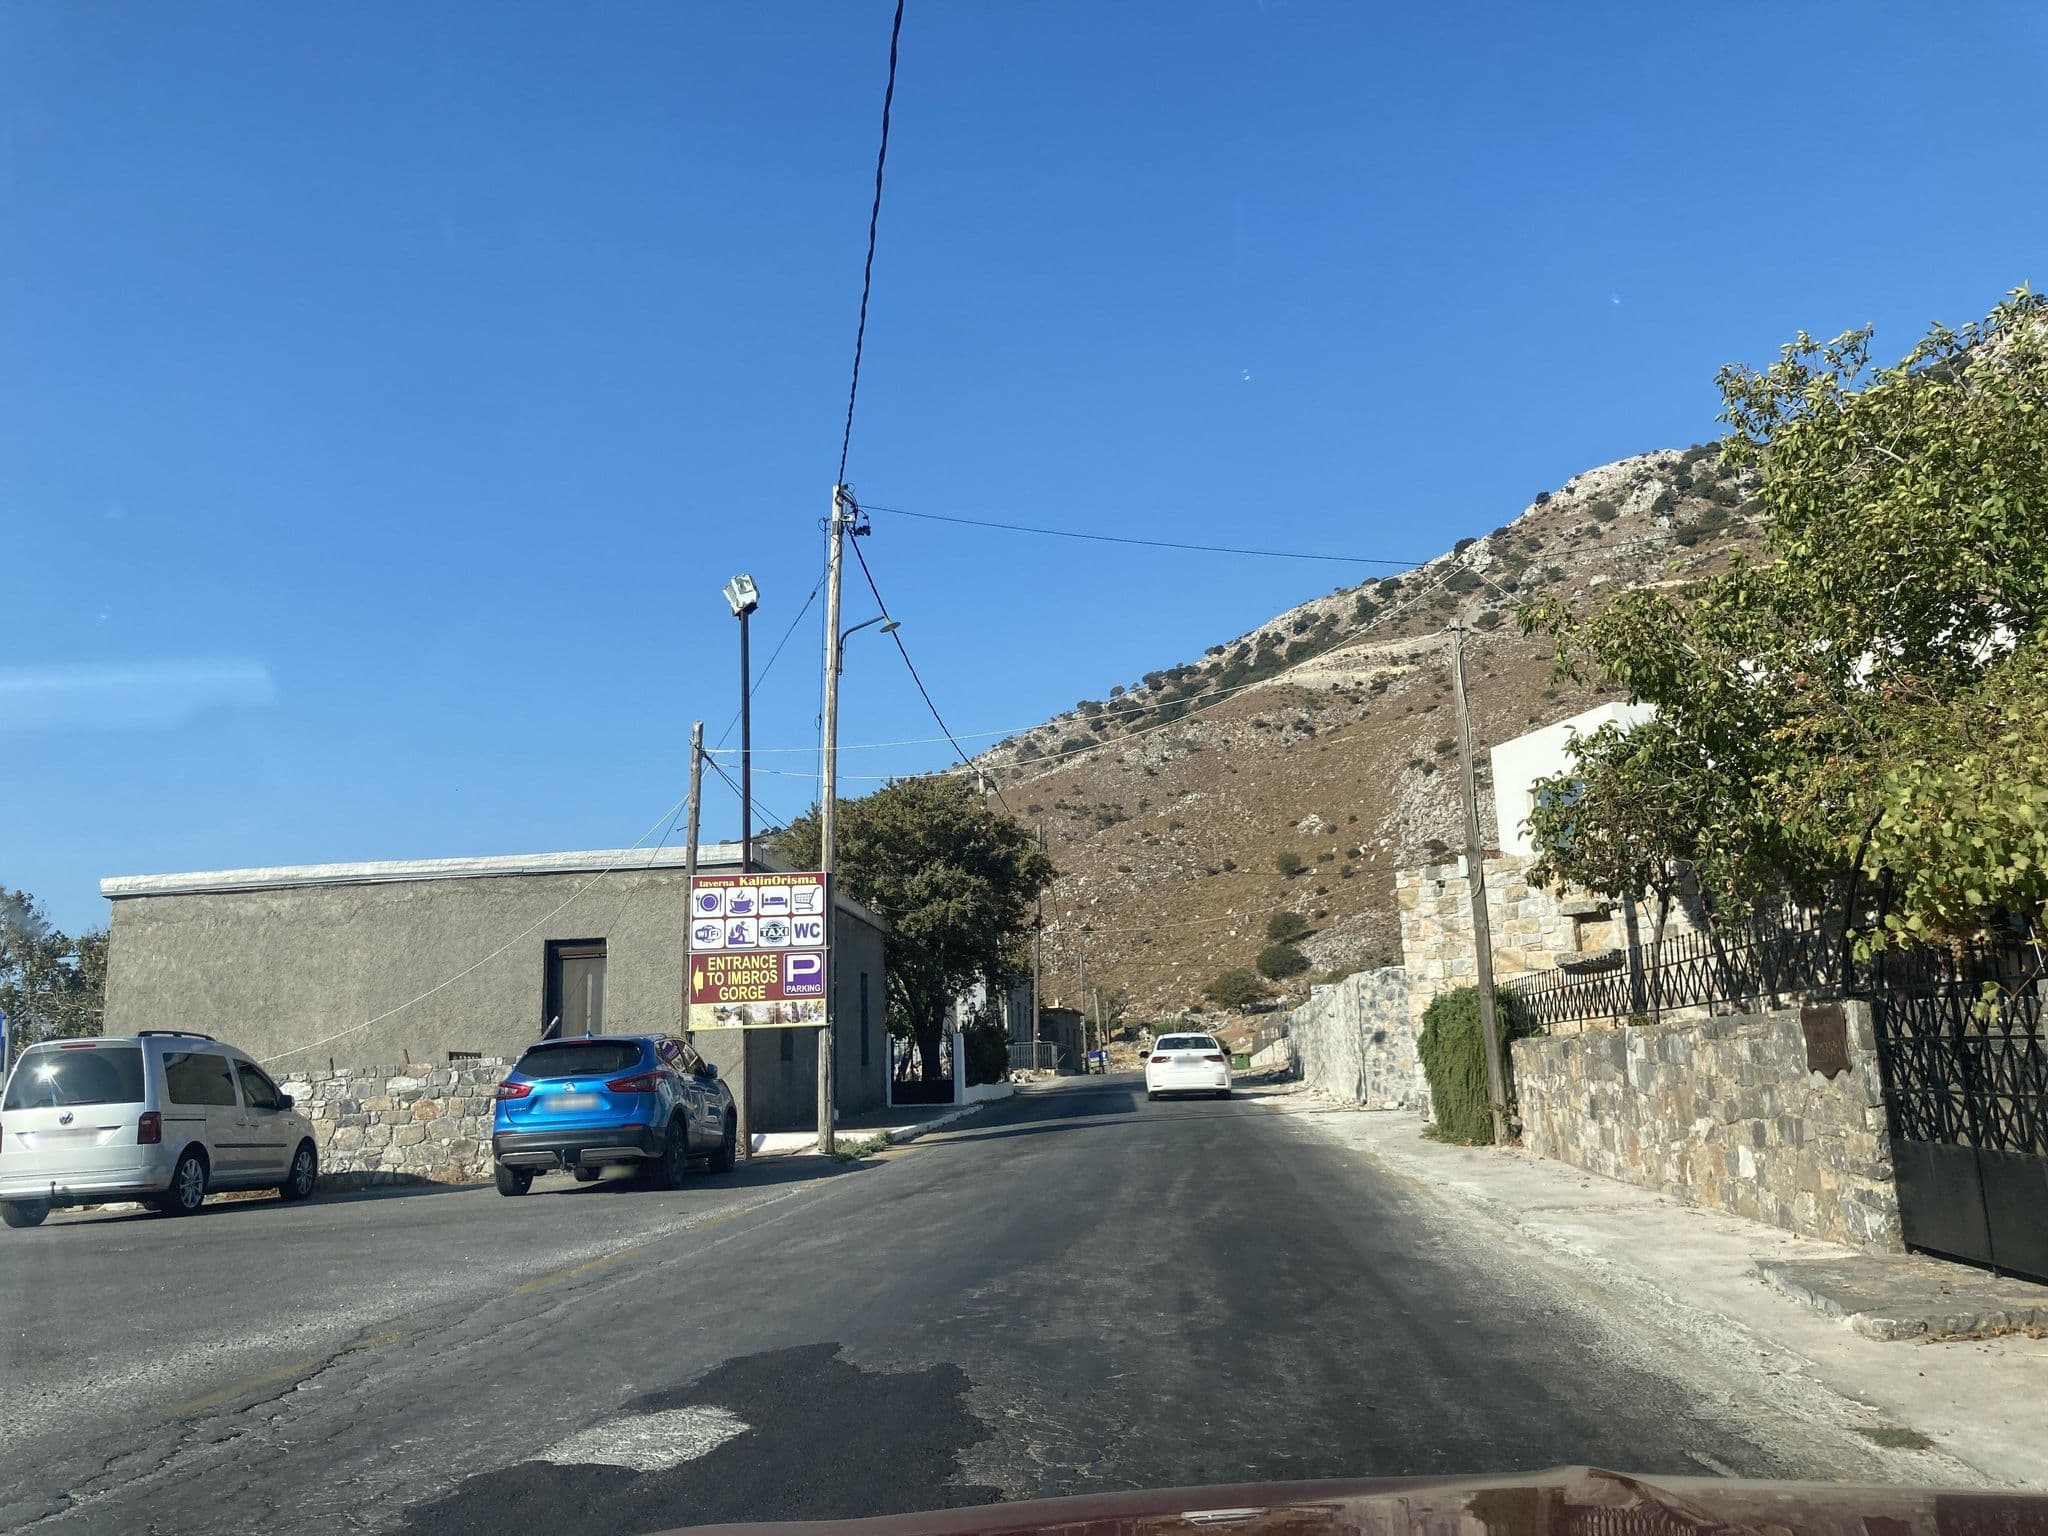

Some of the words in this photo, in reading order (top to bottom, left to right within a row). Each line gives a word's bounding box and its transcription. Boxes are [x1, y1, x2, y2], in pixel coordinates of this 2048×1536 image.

[739, 876, 817, 886] KalinOrisma
[760, 927, 789, 937] TAXI
[794, 922, 820, 938] WC
[707, 954, 778, 971] ENTRANCE
[786, 954, 821, 982] P
[707, 972, 725, 986] TO
[728, 970, 778, 985] IMBROS
[719, 985, 766, 1000] GORGE
[786, 984, 821, 993] PARKING
